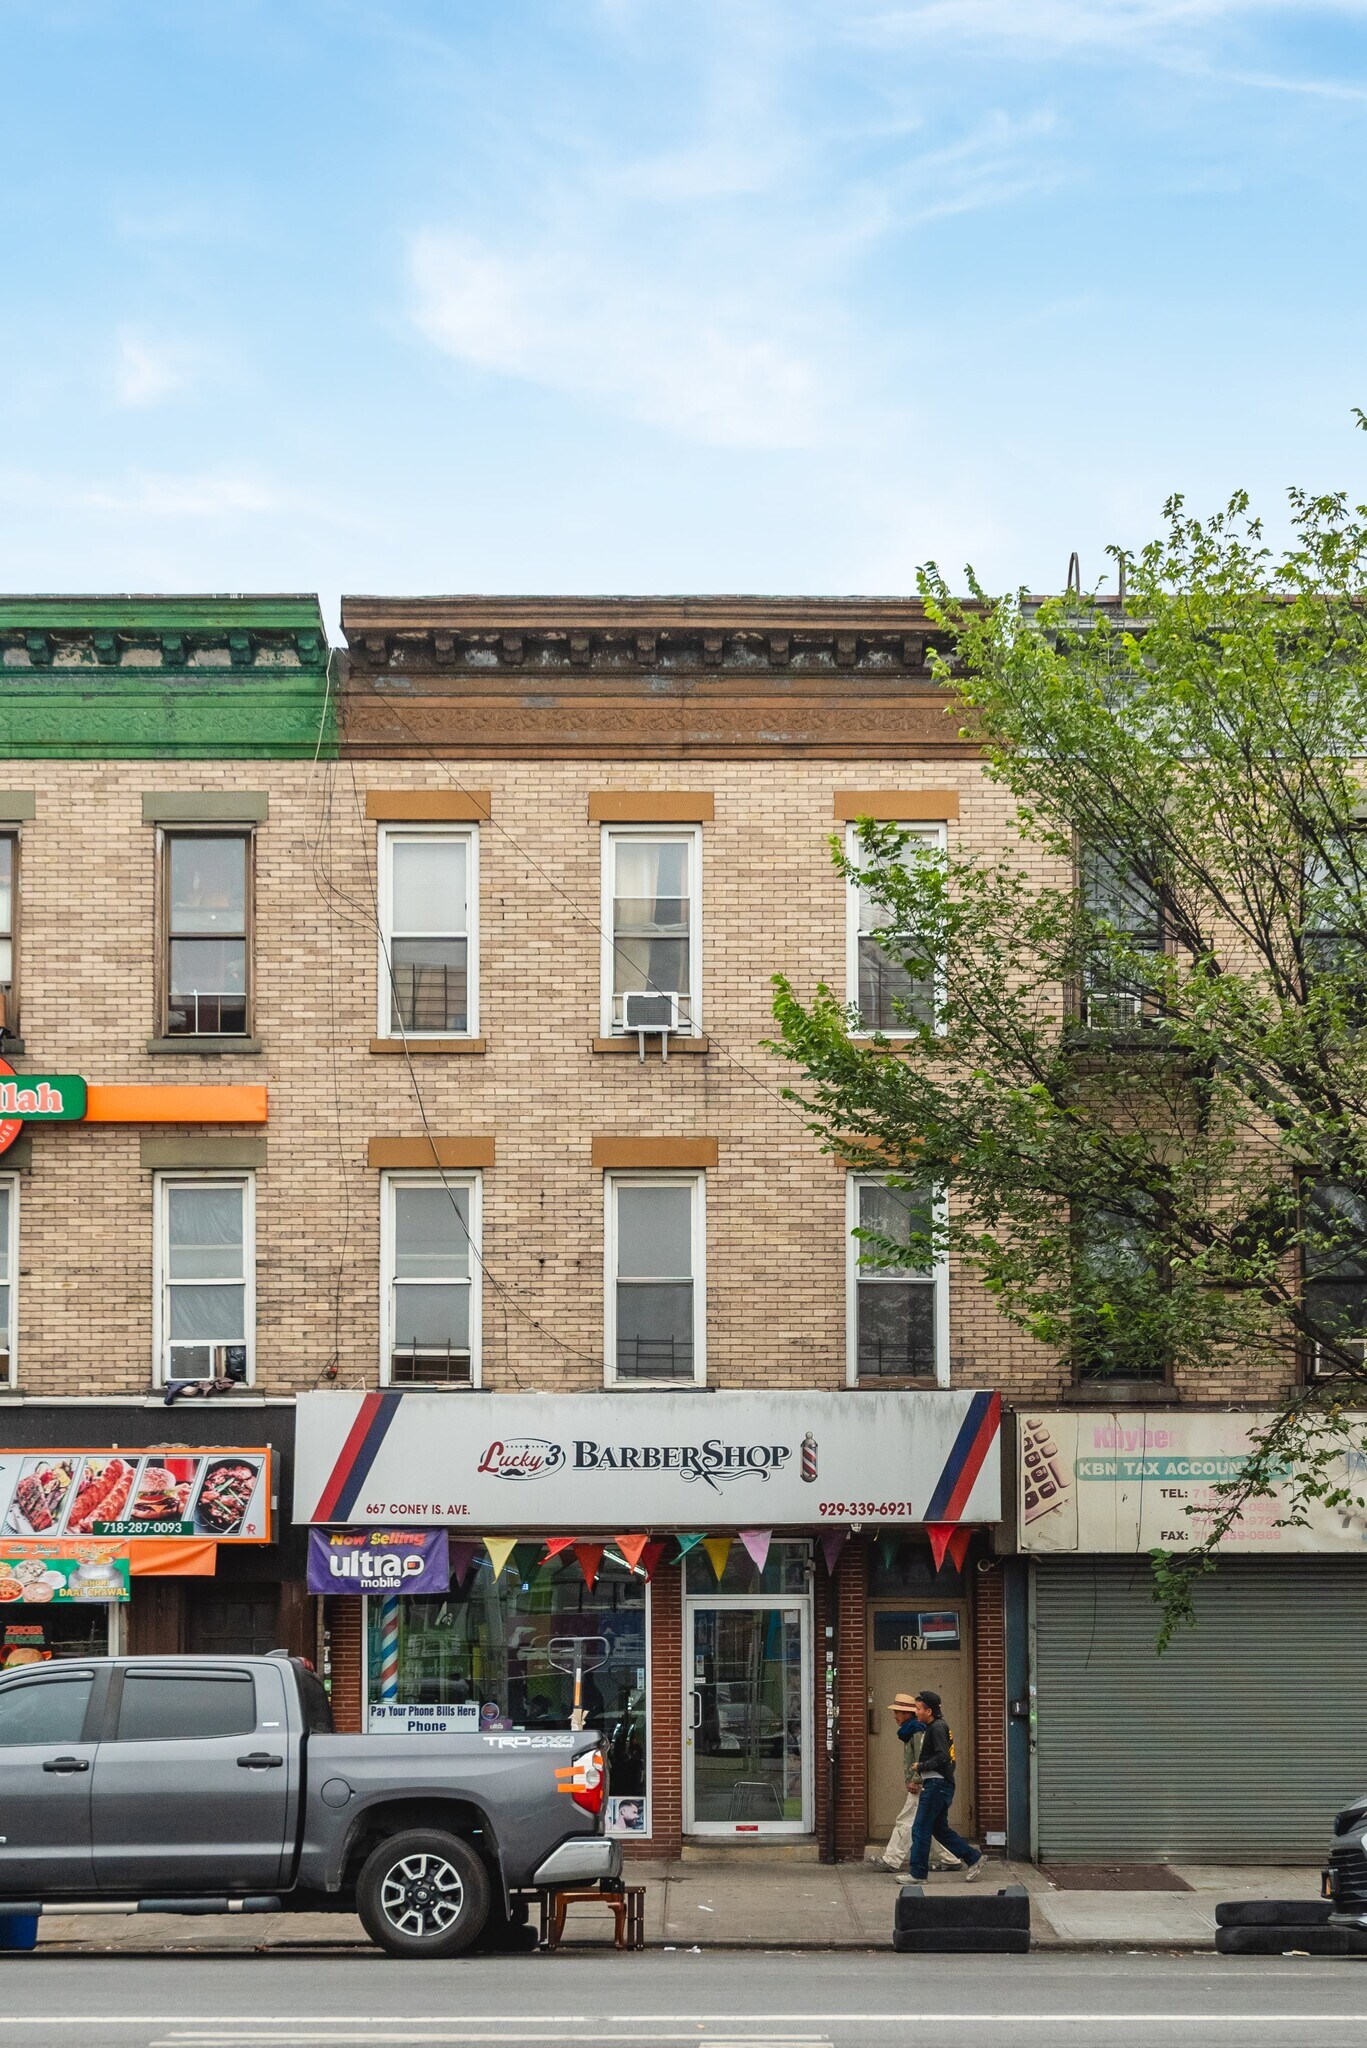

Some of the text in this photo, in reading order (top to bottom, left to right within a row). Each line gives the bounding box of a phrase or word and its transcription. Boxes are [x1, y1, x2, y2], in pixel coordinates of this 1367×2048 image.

[0, 1082, 64, 1113] lah
[477, 1441, 544, 1472] Lucky
[545, 1444, 562, 1466] 3
[1079, 1462, 1288, 1476] KBN TAX ACCOUN
[1160, 1488, 1188, 1498] TEL:
[365, 1504, 470, 1515] 667 CONEY IS. AVE.
[818, 1502, 912, 1516] 929-339-6921
[102, 1522, 182, 1534] 718-287-0093
[329, 1532, 426, 1546] Now Selling
[1160, 1531, 1188, 1541] FAX:
[329, 1550, 402, 1577] ultra
[360, 1577, 402, 1588] mobile
[59, 1587, 129, 1597] DAAL CHAWAL
[901, 1636, 927, 1650] 667
[370, 1706, 386, 1717] Pay
[388, 1706, 406, 1716] Your
[408, 1706, 434, 1716] Phone
[436, 1705, 455, 1716] Bills
[457, 1706, 476, 1716] Here
[407, 1720, 447, 1732] Phone
[483, 1736, 531, 1749] TRD
